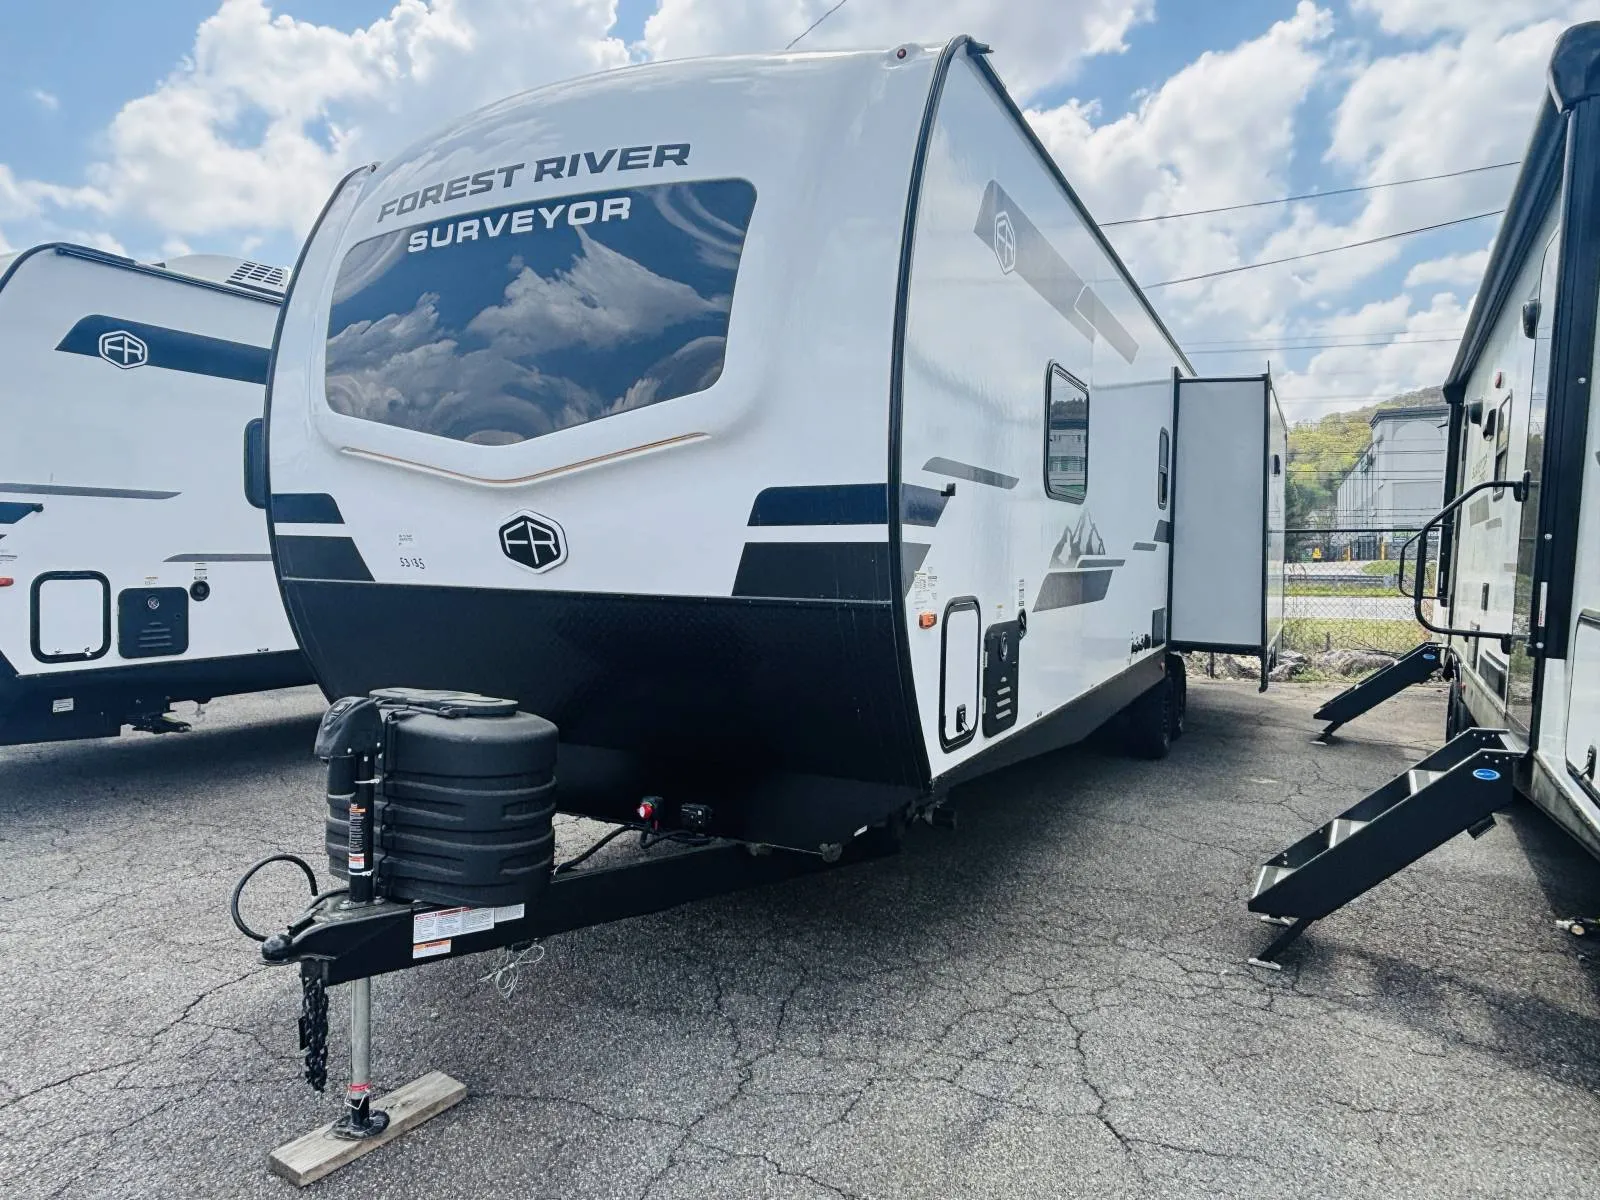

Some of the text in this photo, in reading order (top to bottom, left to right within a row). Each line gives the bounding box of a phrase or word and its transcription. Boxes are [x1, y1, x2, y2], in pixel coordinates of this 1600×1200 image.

[377, 143, 691, 223] FOREST RIVER
[407, 197, 631, 252] SURVEYOR
[104, 335, 142, 364] FR
[503, 520, 557, 565] FR
